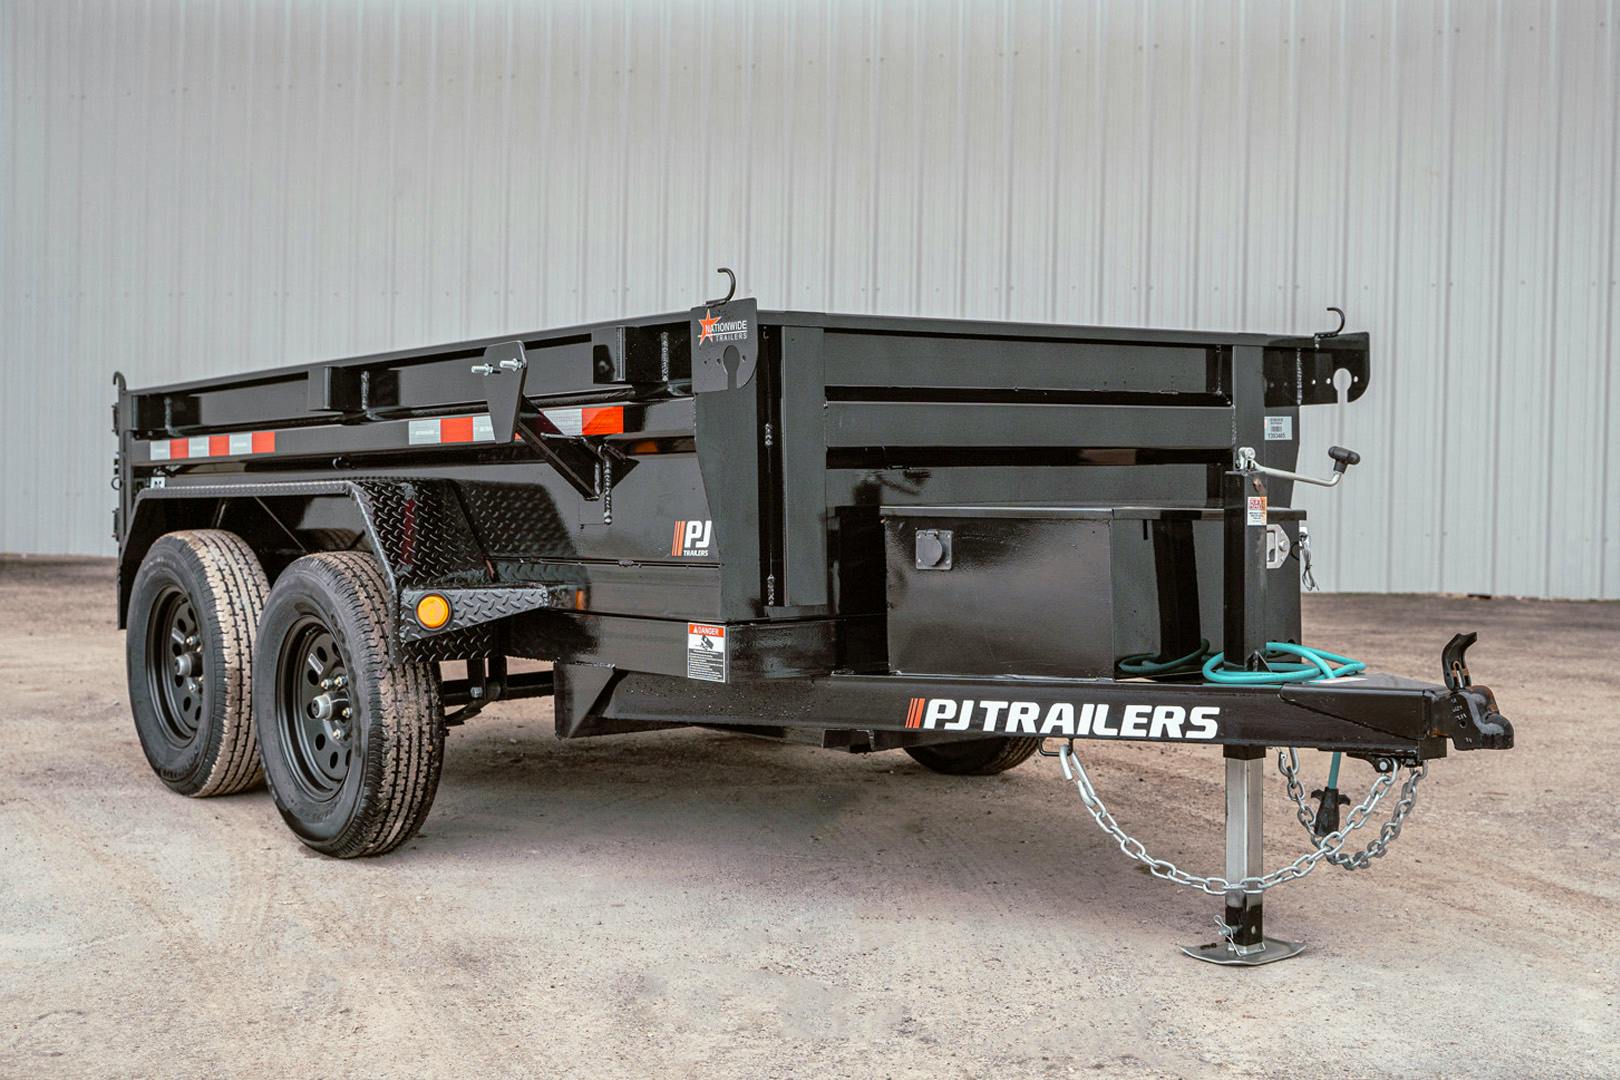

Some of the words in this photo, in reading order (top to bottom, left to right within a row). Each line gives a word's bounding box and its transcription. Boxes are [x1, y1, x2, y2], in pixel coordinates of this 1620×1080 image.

[705, 320, 748, 333] NATIONWIDE
[716, 332, 748, 342] TRAILERS
[684, 520, 712, 548] PJ
[683, 549, 709, 557] TRAILERS
[698, 625, 720, 636] DANGER
[923, 698, 974, 731] PJ
[979, 700, 1221, 740] TRAILERS
